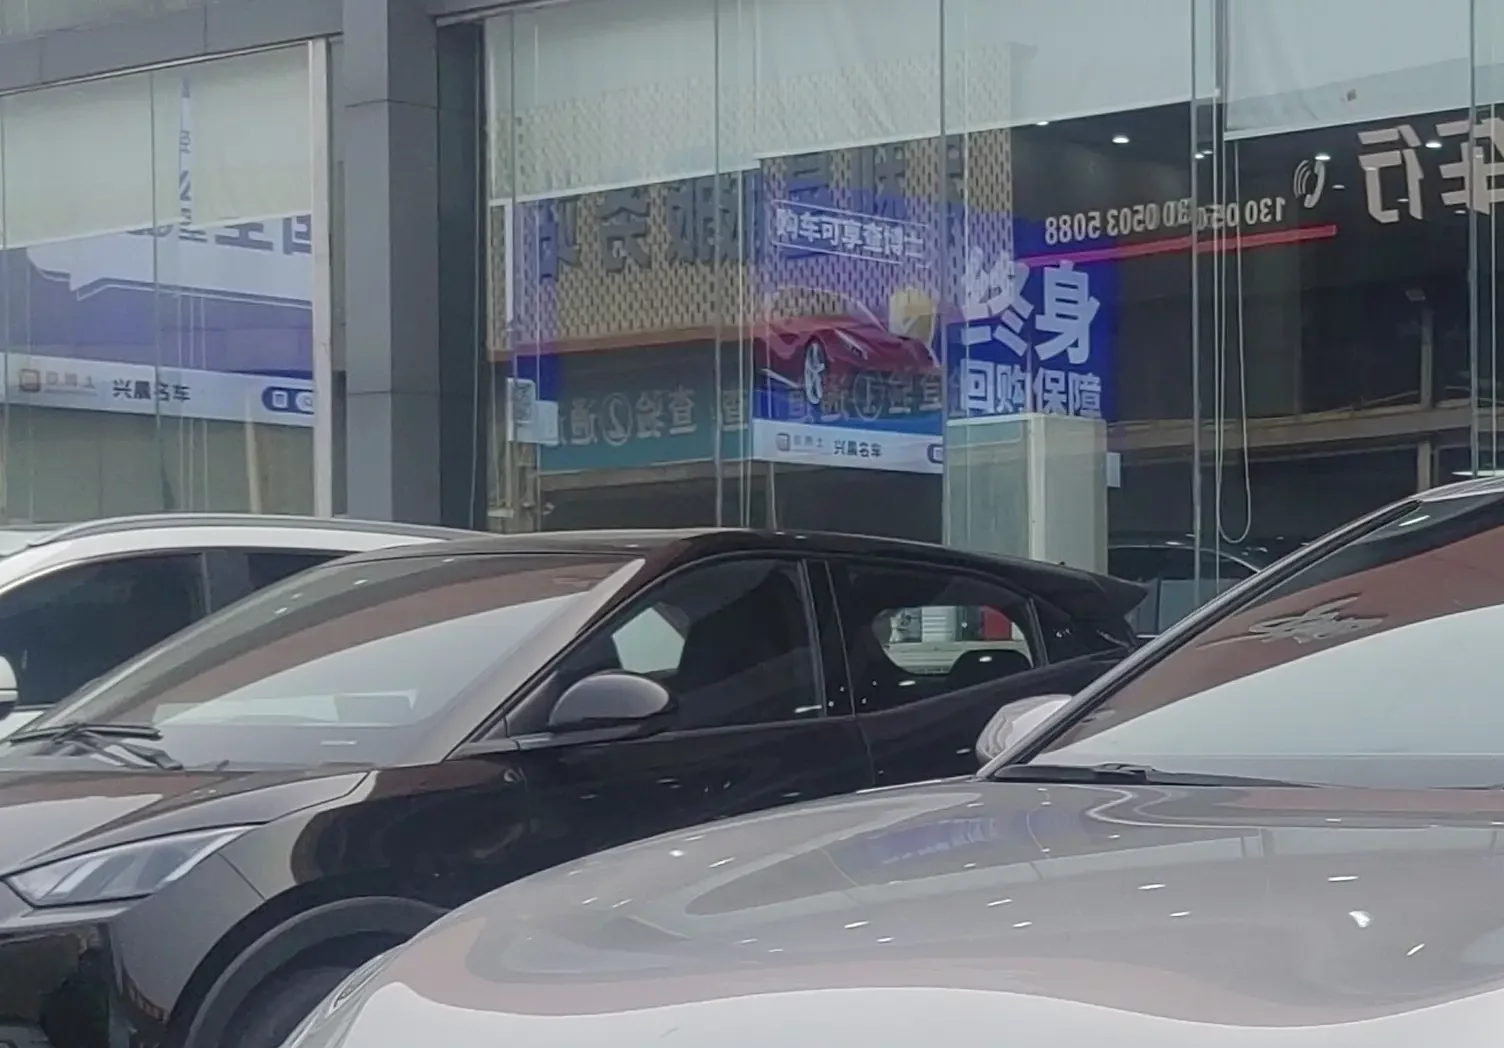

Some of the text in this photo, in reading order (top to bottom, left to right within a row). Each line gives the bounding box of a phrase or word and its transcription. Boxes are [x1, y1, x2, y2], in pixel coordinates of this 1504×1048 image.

[960, 247, 1101, 365] 终身
[959, 358, 1102, 420] 回购保障
